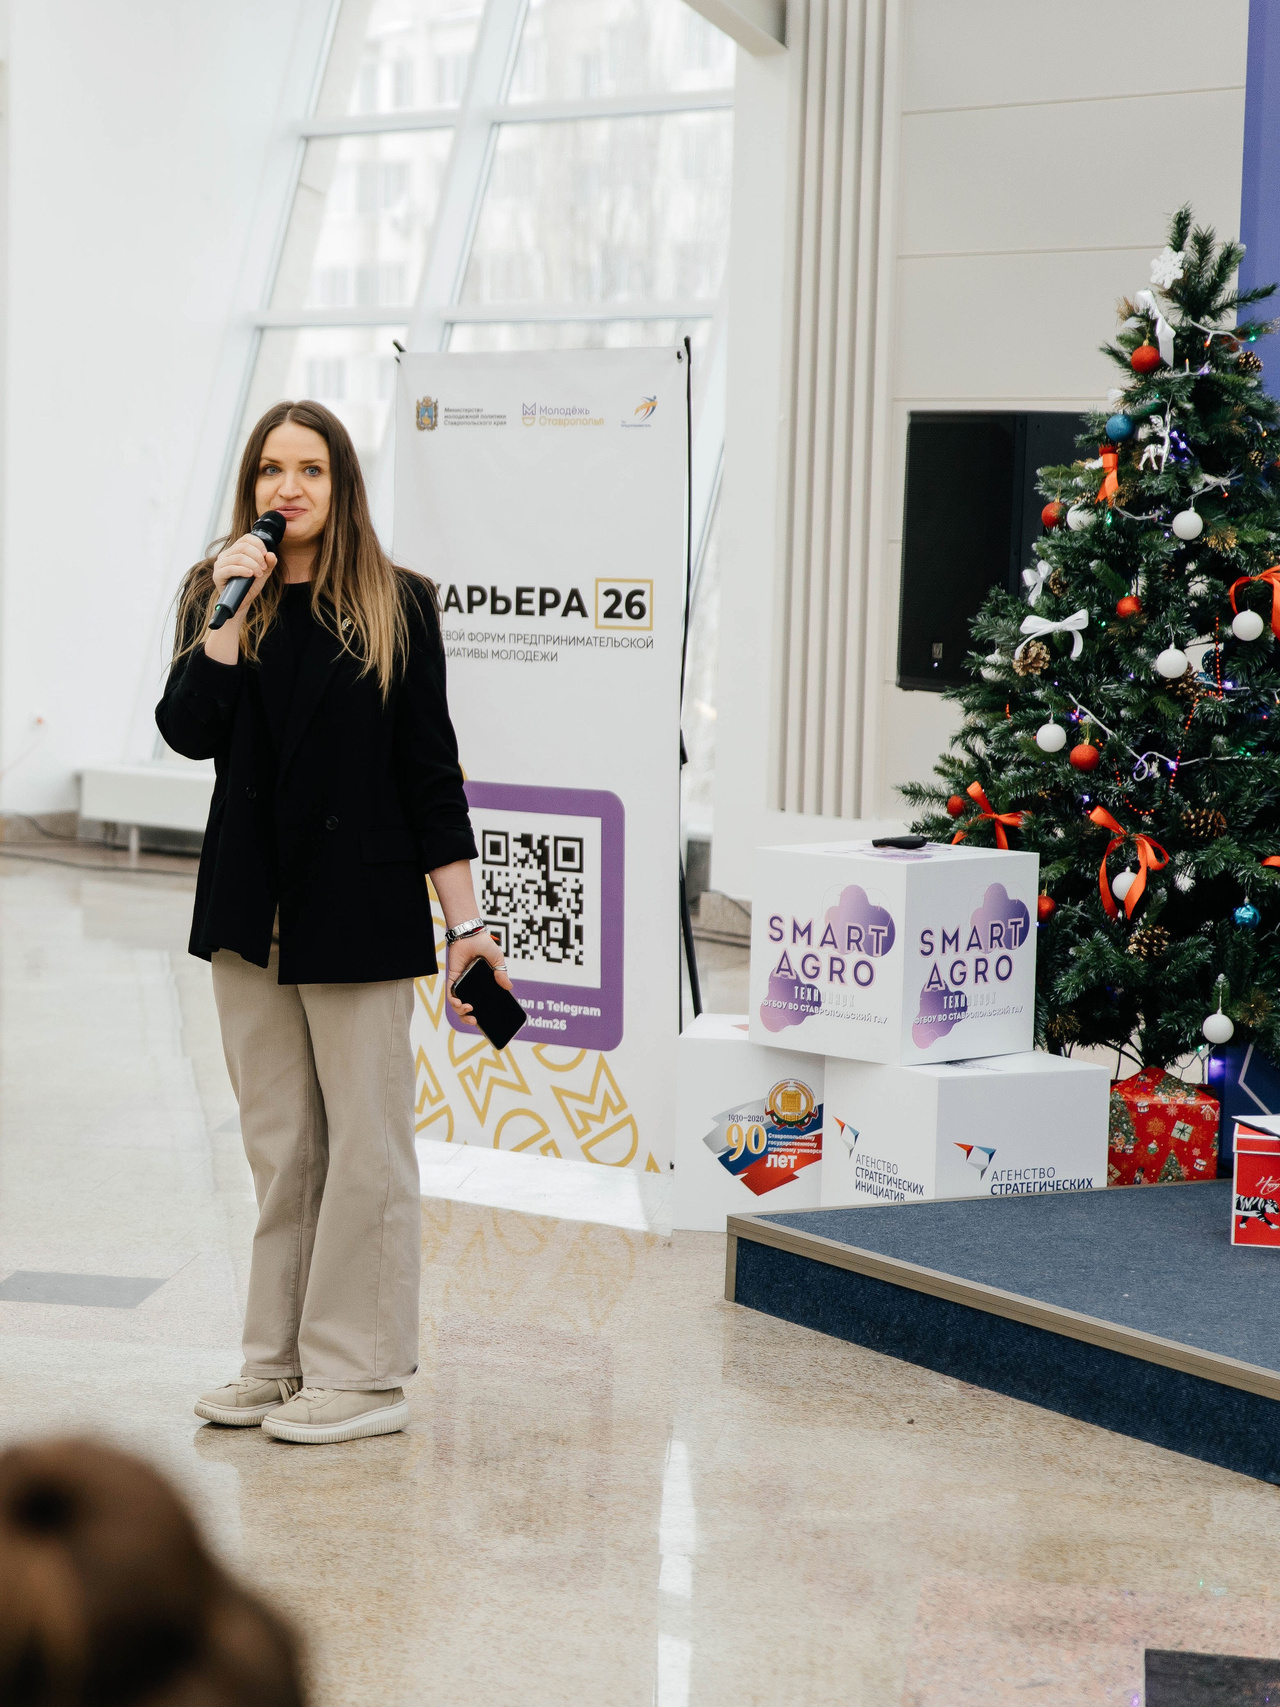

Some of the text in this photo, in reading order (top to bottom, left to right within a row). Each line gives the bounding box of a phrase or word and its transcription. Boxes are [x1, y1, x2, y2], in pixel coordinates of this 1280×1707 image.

[539, 405, 590, 416] Молодёжь
[539, 416, 604, 427] Ставрополья
[602, 588, 647, 620] 26
[467, 631, 506, 643] ФОРУМ
[508, 633, 654, 649] ПРЕДПРИНИМАТЕЛЬСКОЙ
[491, 649, 558, 662] МОЛОДЕЖИ
[768, 914, 887, 956] SMART
[920, 919, 1023, 957] SMART
[775, 949, 875, 988] AGRO
[925, 954, 1013, 990] AGRO
[546, 999, 601, 1017] Telegram
[726, 1123, 767, 1162] 90
[766, 1154, 798, 1169] лет
[856, 1153, 898, 1175] АГЕНСТВО
[855, 1166, 924, 1196] СТРАТЕГИЧЕСКИХ
[990, 1166, 1056, 1182] АГЕНСТВО
[855, 1179, 905, 1202] ИНИЦИАТИВ
[990, 1177, 1094, 1195] СТРАТЕГИЧЕСКИХ
